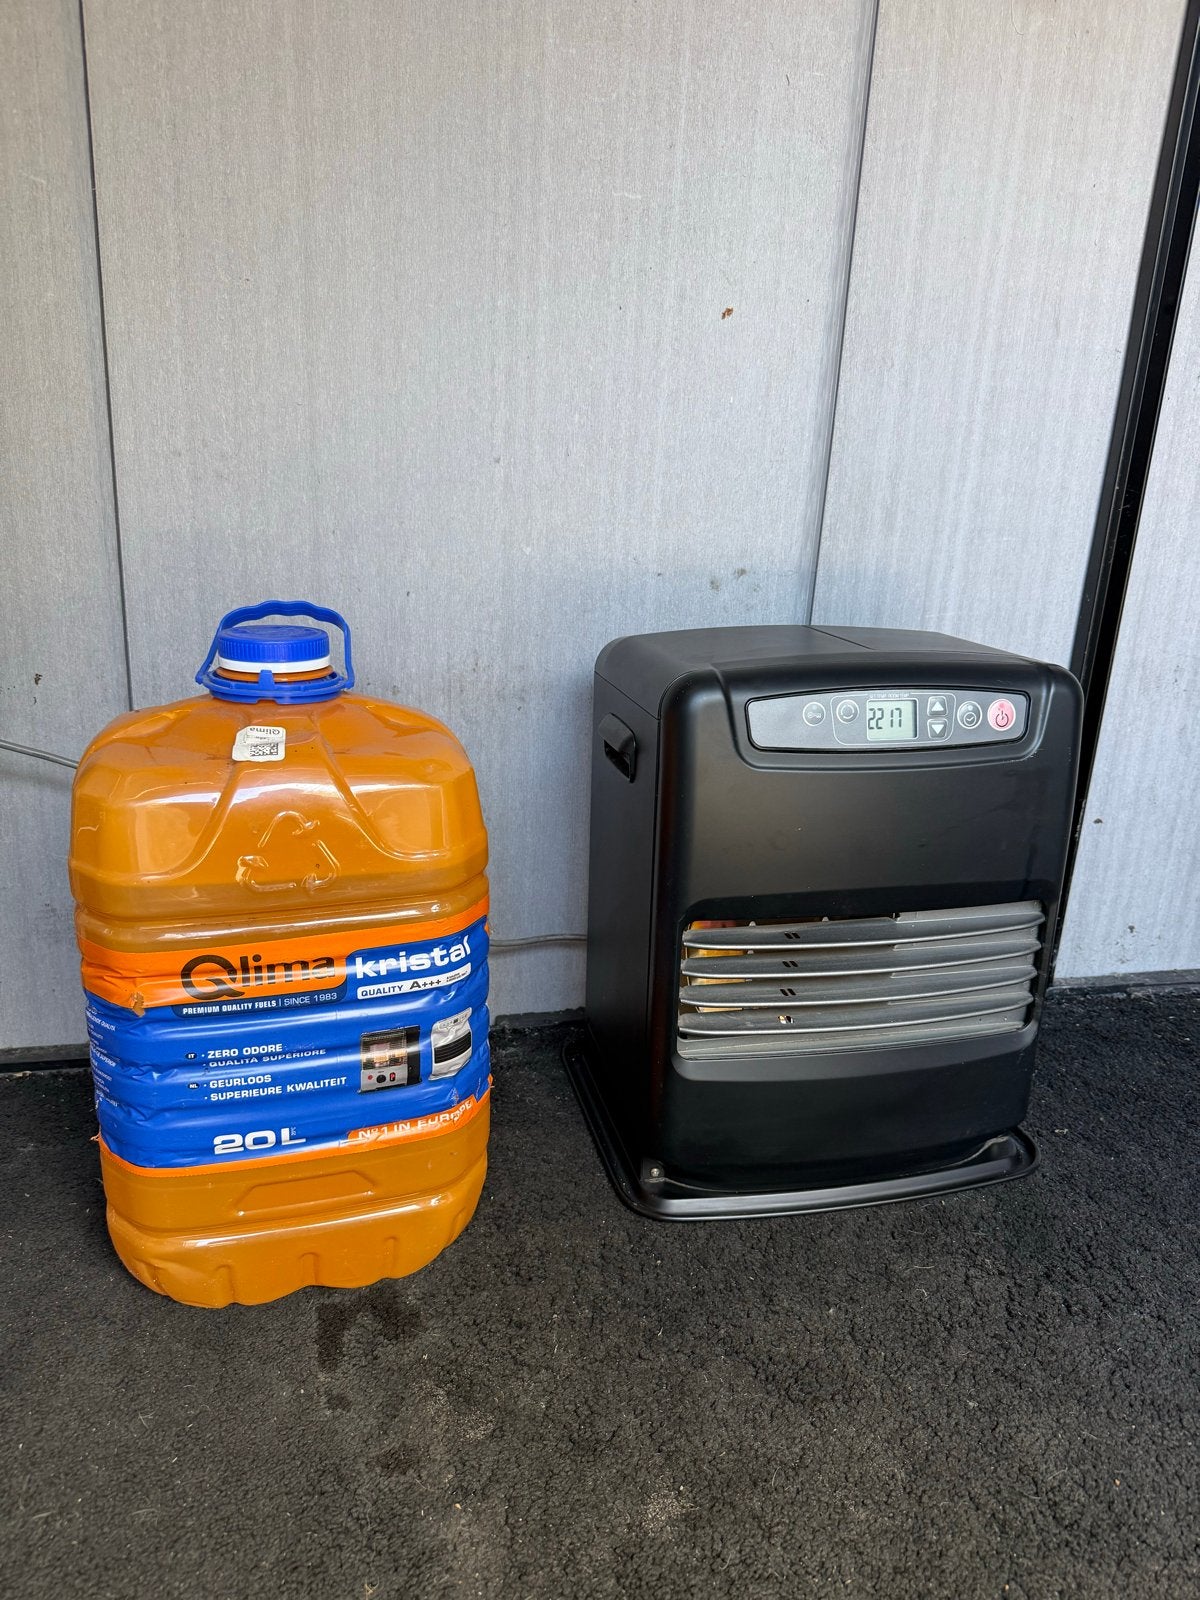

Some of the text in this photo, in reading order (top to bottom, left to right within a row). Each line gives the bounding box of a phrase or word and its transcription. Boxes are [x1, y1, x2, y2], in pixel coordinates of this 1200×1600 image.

[355, 935, 471, 979] kristal
[180, 954, 336, 1001] Qlima
[361, 980, 442, 997] QUALITY A+++
[182, 992, 338, 1015] PREMIUM QUALITY FUELS SINCE 1983
[207, 1048, 239, 1060] ZERO
[242, 1043, 283, 1056] ODORE
[262, 1048, 327, 1062] SUPERIORE
[209, 1074, 272, 1089] GEURLOOS
[210, 1076, 348, 1102] SUPERIEURE KWALITEIT
[393, 1121, 411, 1133] IN
